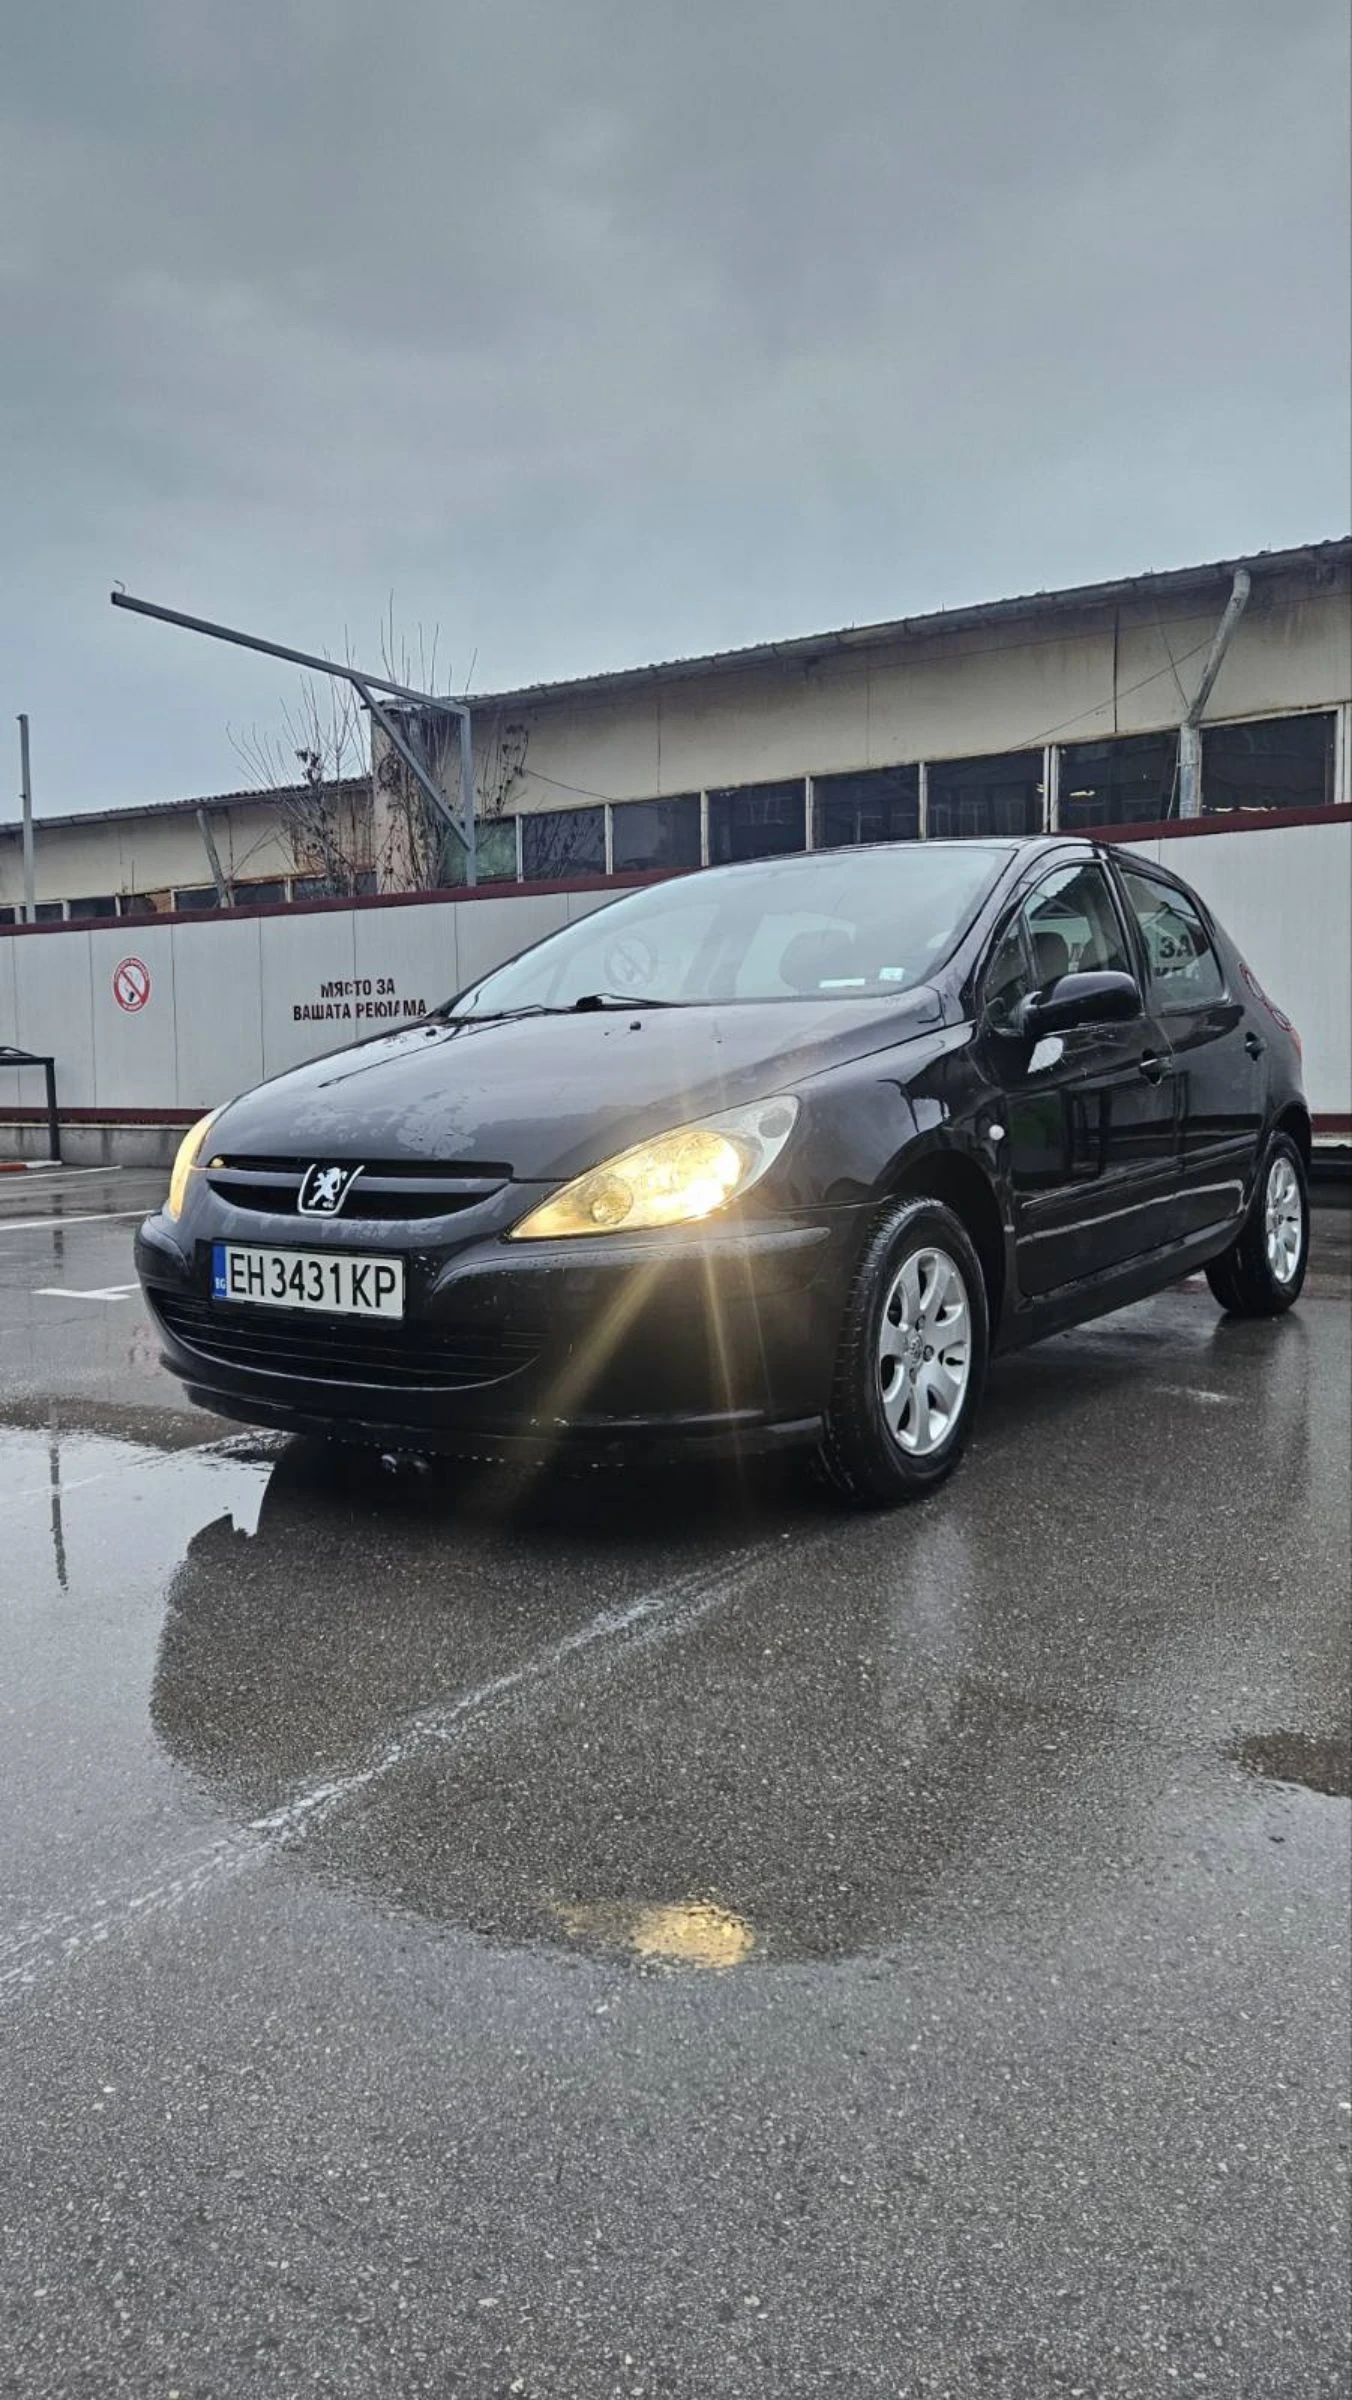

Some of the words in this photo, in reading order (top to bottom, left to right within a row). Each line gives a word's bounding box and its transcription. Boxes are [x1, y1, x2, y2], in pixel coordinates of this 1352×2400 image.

[320, 980, 371, 998] МЯСТО
[376, 978, 395, 995] ЗА
[293, 1003, 351, 1020] ВАШАТА
